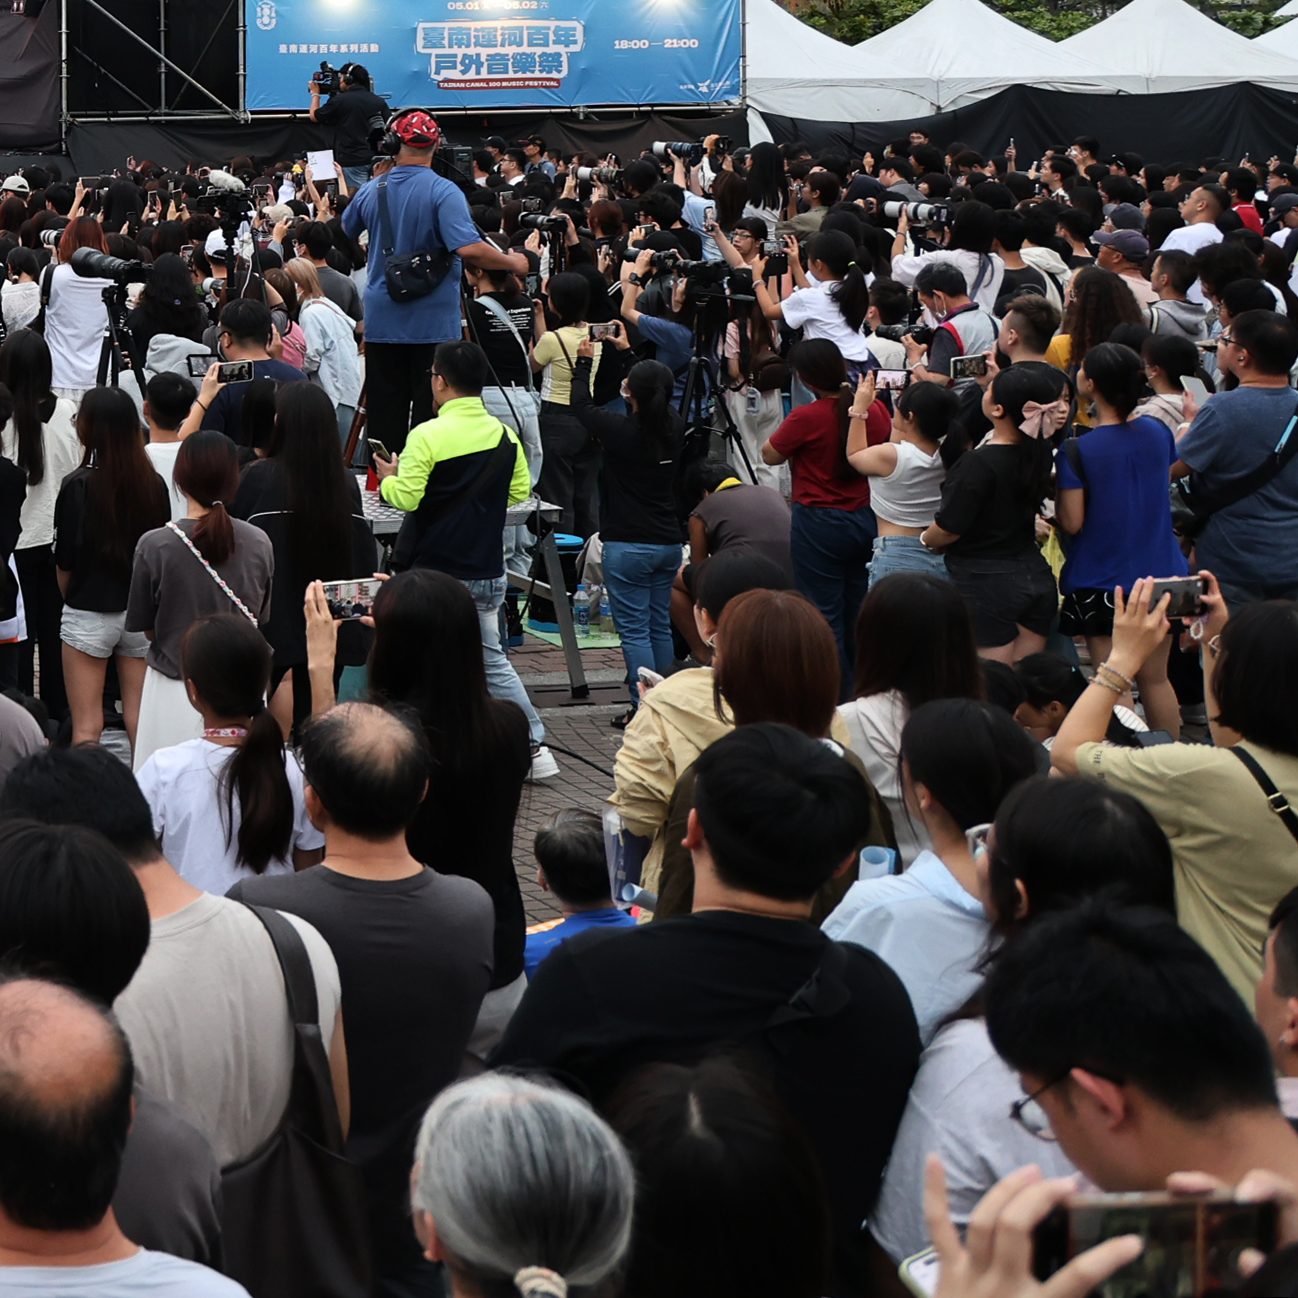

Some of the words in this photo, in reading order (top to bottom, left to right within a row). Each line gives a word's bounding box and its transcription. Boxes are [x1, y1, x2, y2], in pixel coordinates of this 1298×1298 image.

[422, 25, 579, 49] 臺南運河百年
[614, 39, 650, 49] 18:00
[664, 38, 700, 48] 21:00
[434, 52, 564, 76] 戶外音樂祭
